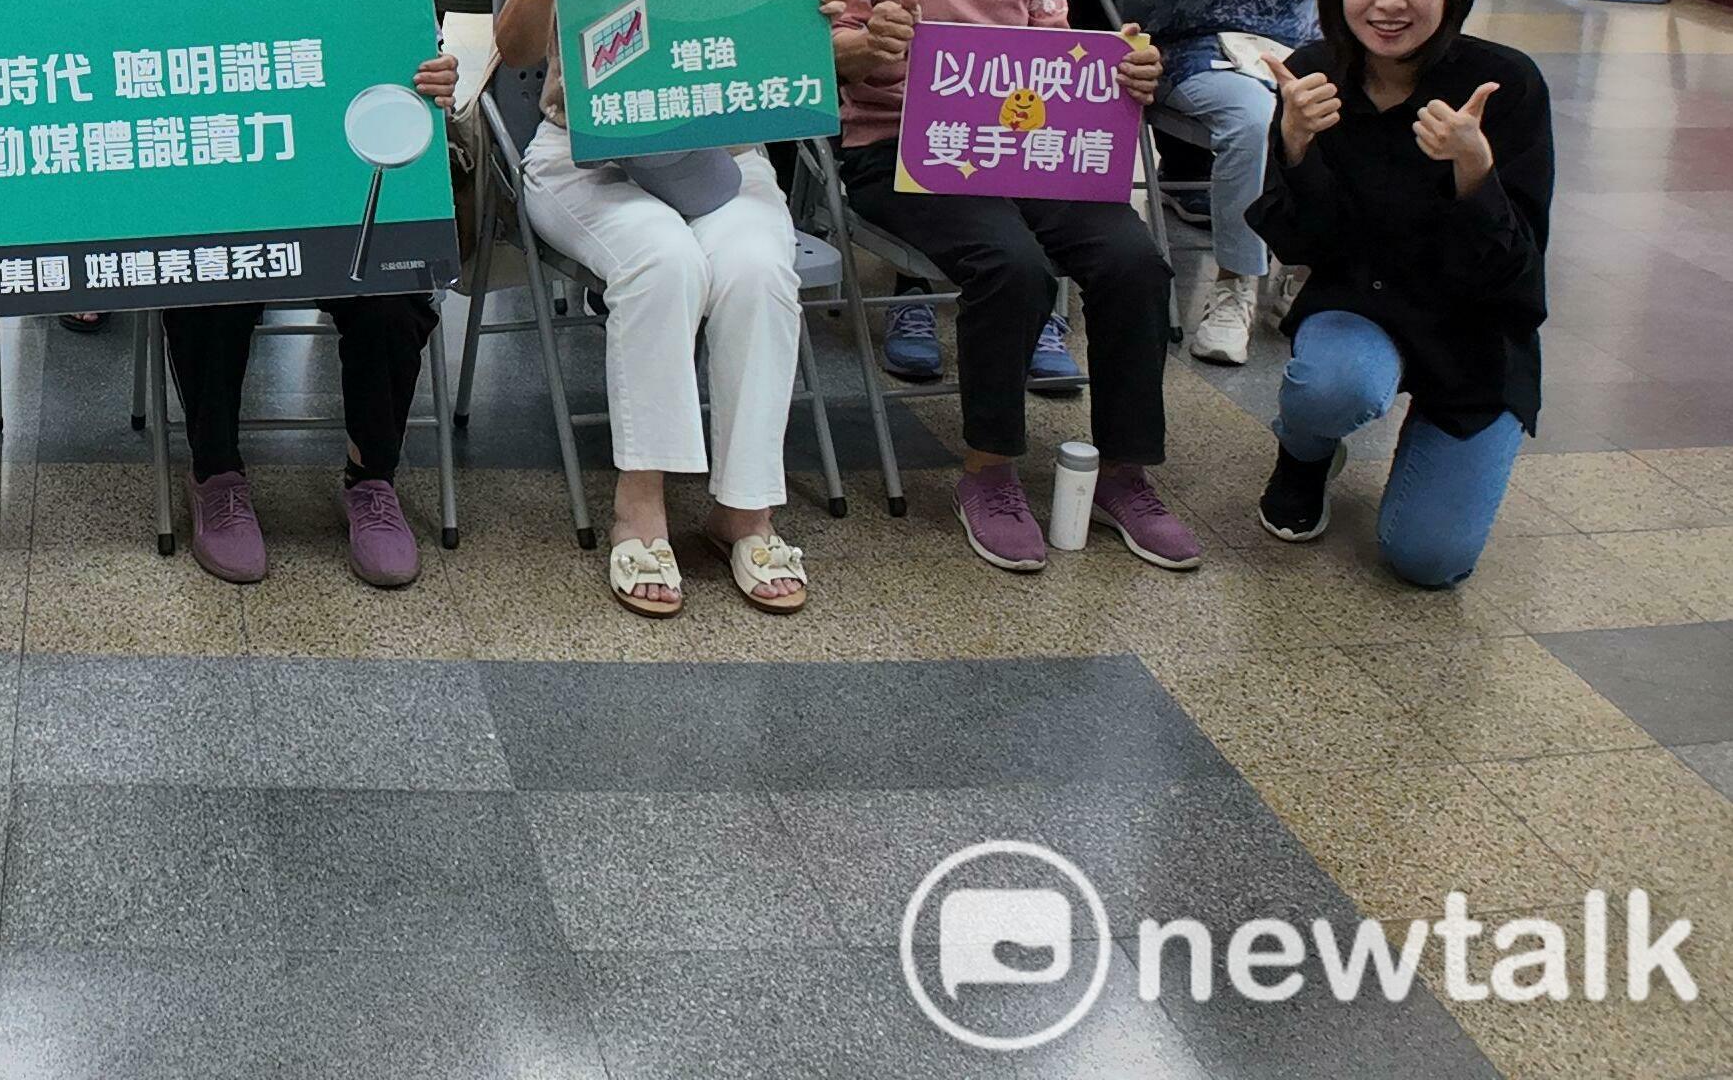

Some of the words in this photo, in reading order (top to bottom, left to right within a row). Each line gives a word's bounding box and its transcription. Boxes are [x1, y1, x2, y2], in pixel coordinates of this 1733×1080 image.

[112, 37, 326, 101] 聰明識讀
[669, 36, 738, 73] 增強
[929, 49, 1120, 103] 以心映心
[589, 73, 822, 127] 媒體識讀免疫力
[922, 120, 1115, 175] 雙手傳情
[84, 240, 303, 287] 媒體素養系列
